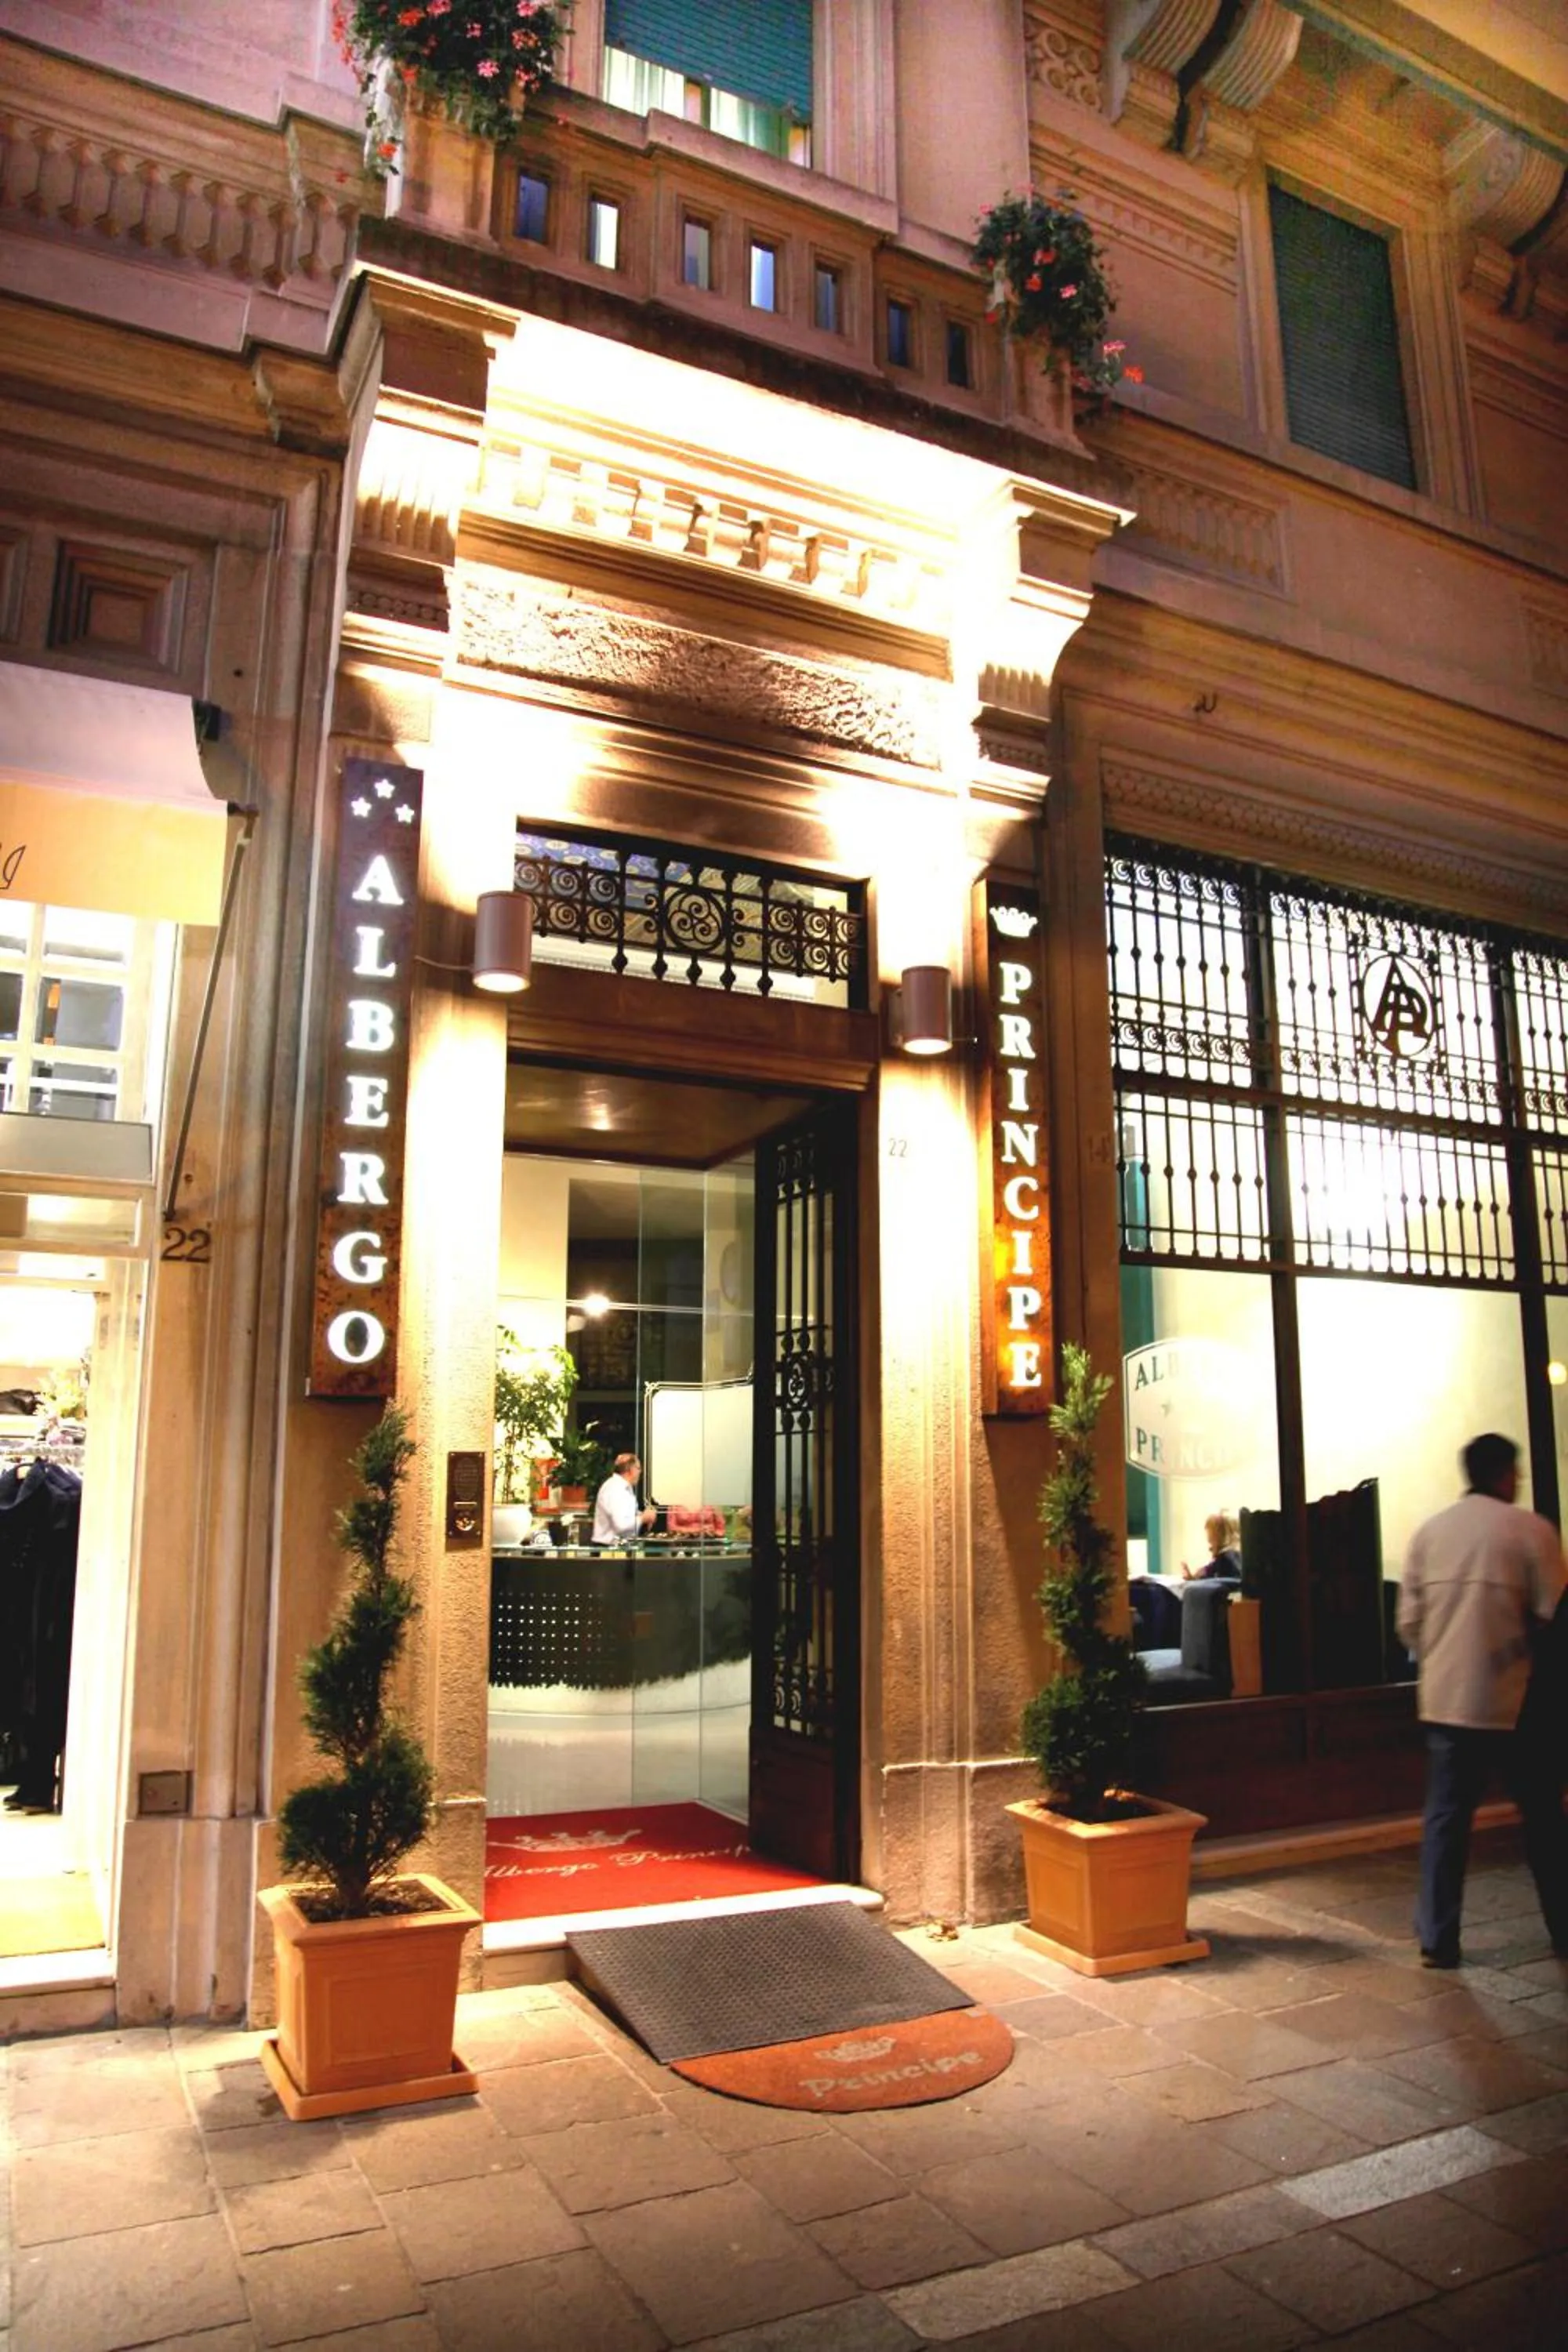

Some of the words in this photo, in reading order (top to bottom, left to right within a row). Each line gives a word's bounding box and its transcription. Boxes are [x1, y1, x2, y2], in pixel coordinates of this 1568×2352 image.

[327, 853, 405, 1364] ALBERGO
[887, 1137, 908, 1159] 22
[1000, 961, 1042, 1388] PRINCIPE
[161, 1227, 211, 1263] 22
[799, 2047, 985, 2100] Principe
